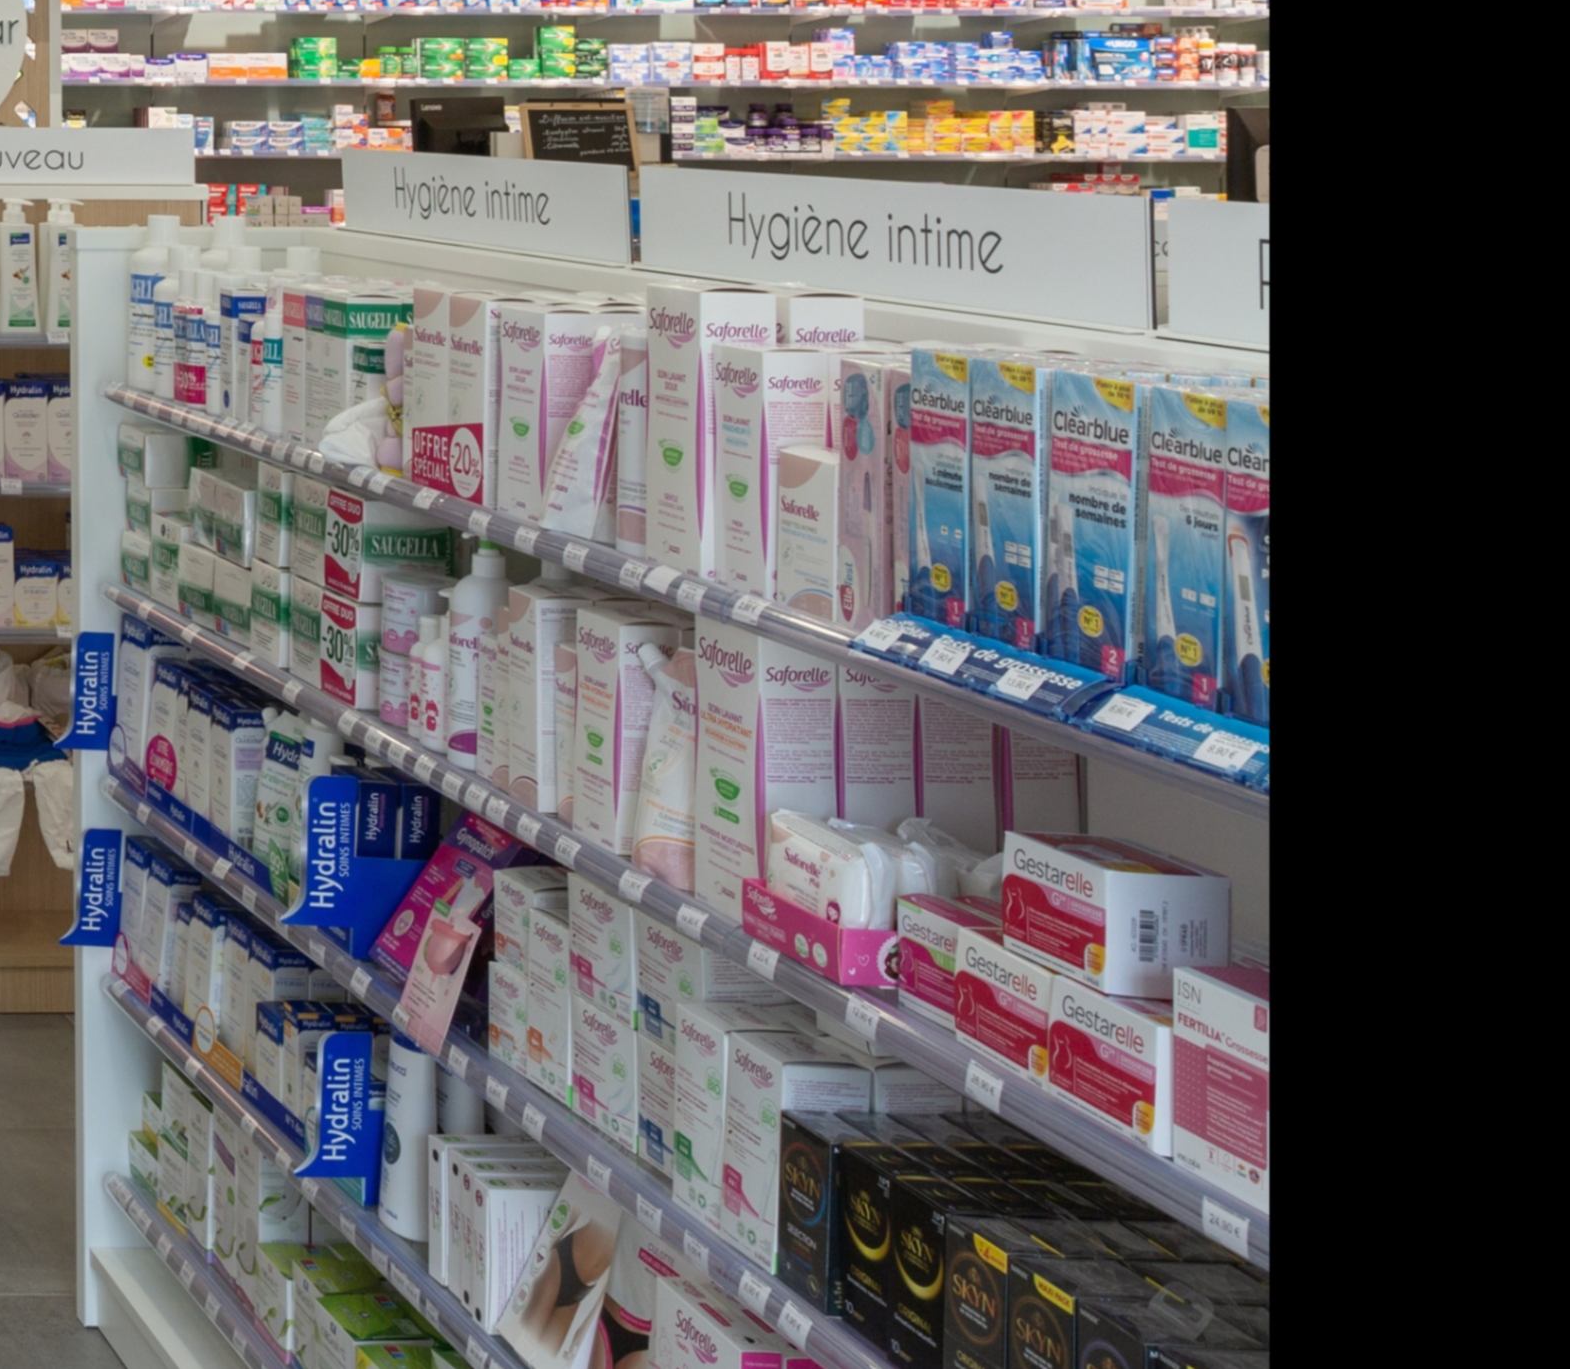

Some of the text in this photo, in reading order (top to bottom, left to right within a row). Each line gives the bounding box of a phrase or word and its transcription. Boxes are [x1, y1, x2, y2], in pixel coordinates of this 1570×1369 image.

[393, 165, 551, 226] Hygiène intime
[727, 191, 1004, 276] Hygiène intime
[349, 311, 400, 329] SAUGELLA
[648, 308, 695, 335] Saforelle
[706, 321, 768, 341] Saforelle
[795, 327, 857, 345] Saforelle
[549, 333, 593, 348] Saforelle
[715, 362, 757, 386] Saforelle
[767, 375, 821, 394] Saforelle
[10, 385, 43, 397] Hydralin
[911, 387, 965, 414] Clearblue
[973, 398, 1033, 426] Clearblue
[1053, 409, 1130, 445] Clearblue
[412, 429, 449, 463] OFFRE
[450, 439, 482, 480] -20%
[1151, 431, 1223, 464] Clearblue
[1227, 446, 1269, 473] Clear
[412, 457, 450, 484] SPÉCIALE
[780, 498, 820, 522] Saforelle
[1068, 492, 1110, 512] nombre
[1074, 508, 1127, 530] semaines
[326, 520, 360, 553] -30%
[371, 533, 440, 556] SAUGELLA
[321, 628, 356, 664] -30%
[699, 636, 752, 675] Saforelle
[100, 652, 110, 691] INTIMES
[765, 666, 831, 685] Saforelle
[76, 651, 106, 735] Hydralin
[364, 791, 381, 841] Hydralin
[408, 794, 424, 844] Hydralin
[310, 801, 344, 908] Hydralin
[338, 802, 351, 877] SOINS INTIMES
[106, 848, 116, 881] INTIMES
[783, 849, 821, 875] Saforelle
[1013, 847, 1094, 899] Gestarelle
[82, 847, 108, 931] Hydralin
[579, 888, 614, 916] Saforelle
[901, 913, 957, 953] Gestarell
[965, 945, 1038, 1003] Gestarelle
[1176, 978, 1202, 1005] ISN
[582, 1009, 618, 1039] Saforelle
[680, 1018, 717, 1048] Saforelle
[1061, 994, 1145, 1056] Gestarelle
[734, 1049, 774, 1082] Saforelle
[1224, 1035, 1269, 1065] Grossesse
[322, 1058, 355, 1161] Hydralin
[352, 1058, 364, 1130] SOINS INTIMES
[784, 1162, 821, 1199] SKYN
[951, 1273, 996, 1317] SKYN
[674, 1308, 719, 1355] Saforelle
[1015, 1318, 1061, 1364] SKYN
